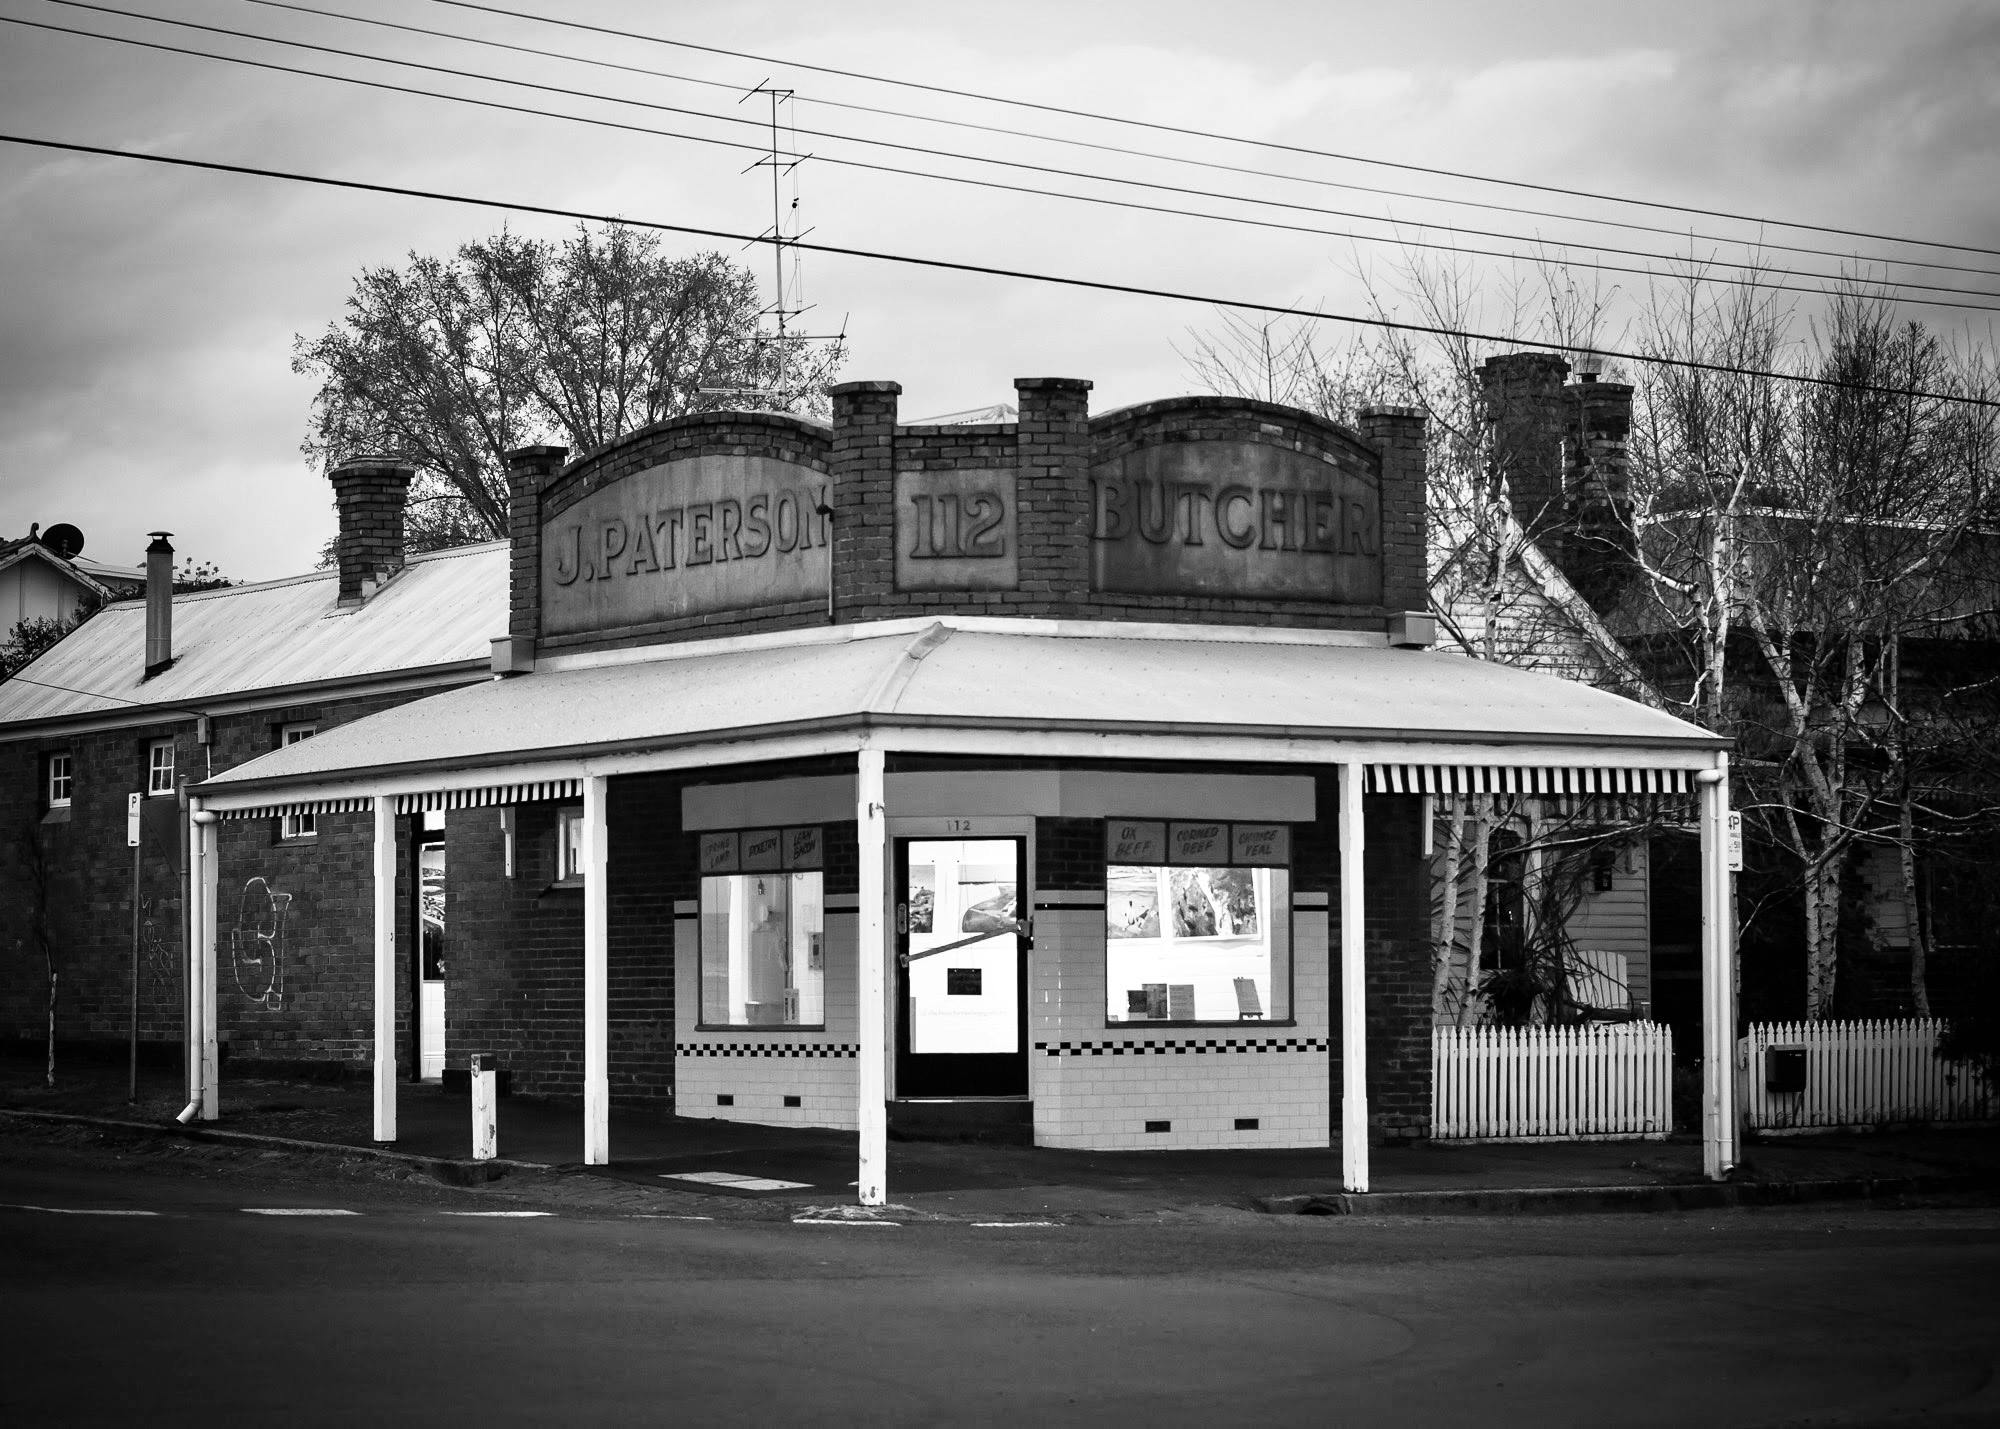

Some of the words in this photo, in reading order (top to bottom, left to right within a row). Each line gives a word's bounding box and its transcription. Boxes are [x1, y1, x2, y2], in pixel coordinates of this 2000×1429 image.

[910, 492, 1005, 559] 112
[1088, 477, 1379, 557] BUTCHER
[555, 485, 827, 586] J.PATERSON
[946, 819, 971, 832] 112
[1121, 826, 1137, 841] OX
[1176, 826, 1219, 842] CORNED
[793, 839, 816, 861] BACON
[1115, 840, 1152, 857] BEEF
[1181, 839, 1214, 856] BEEF
[1245, 843, 1272, 857] VEAL
